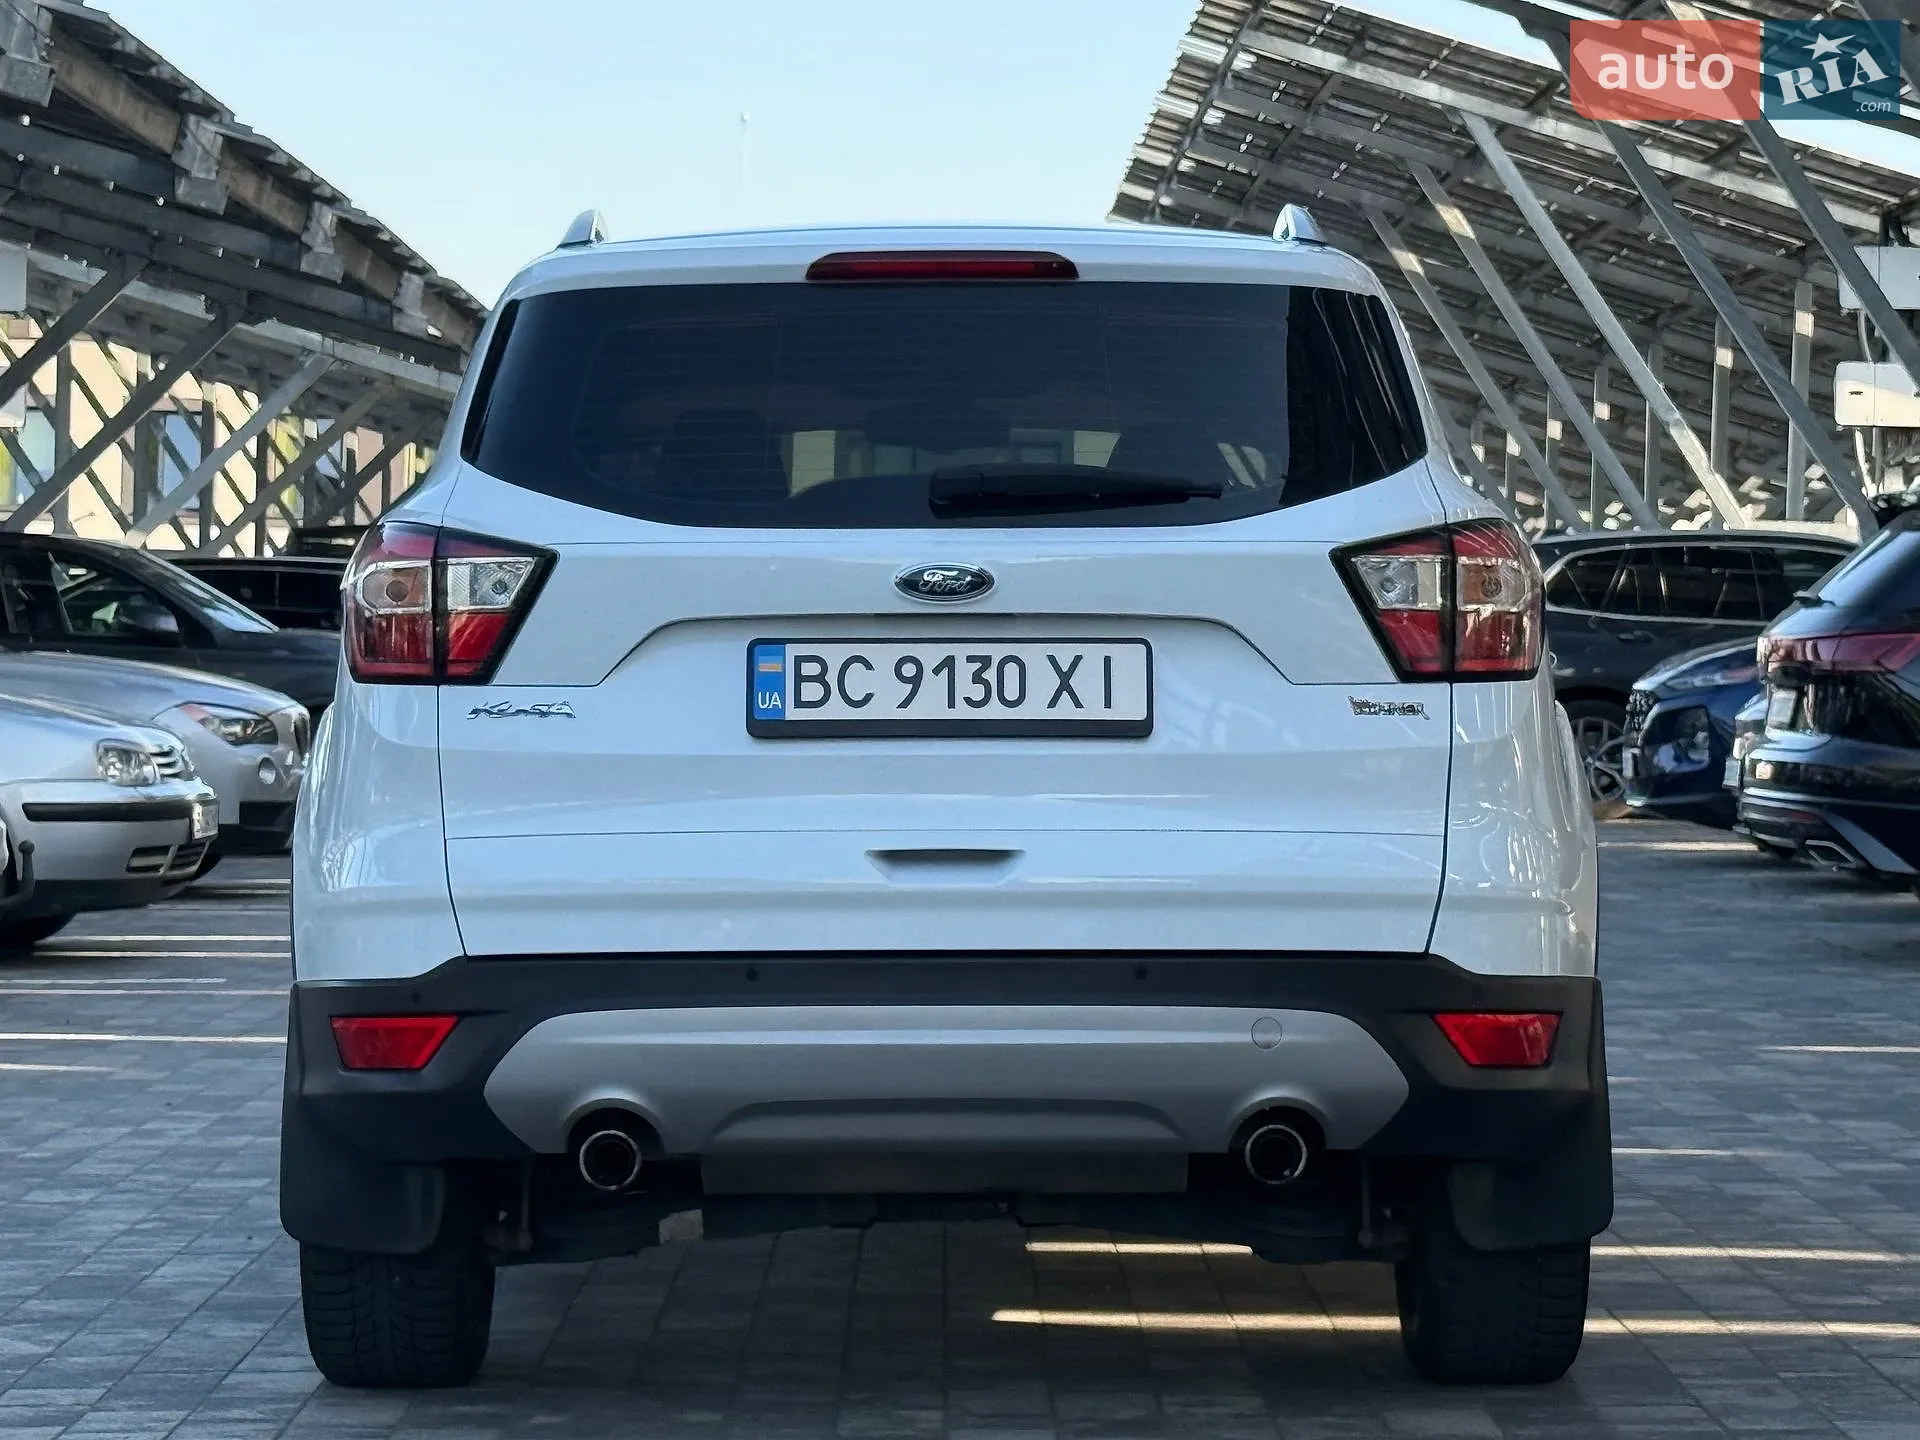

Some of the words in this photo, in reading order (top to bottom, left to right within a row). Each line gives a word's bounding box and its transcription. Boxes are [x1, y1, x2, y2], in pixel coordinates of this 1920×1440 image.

[919, 569, 972, 592] Ford
[793, 655, 876, 709] BC
[893, 655, 1026, 709] 9130
[757, 690, 782, 709] UA
